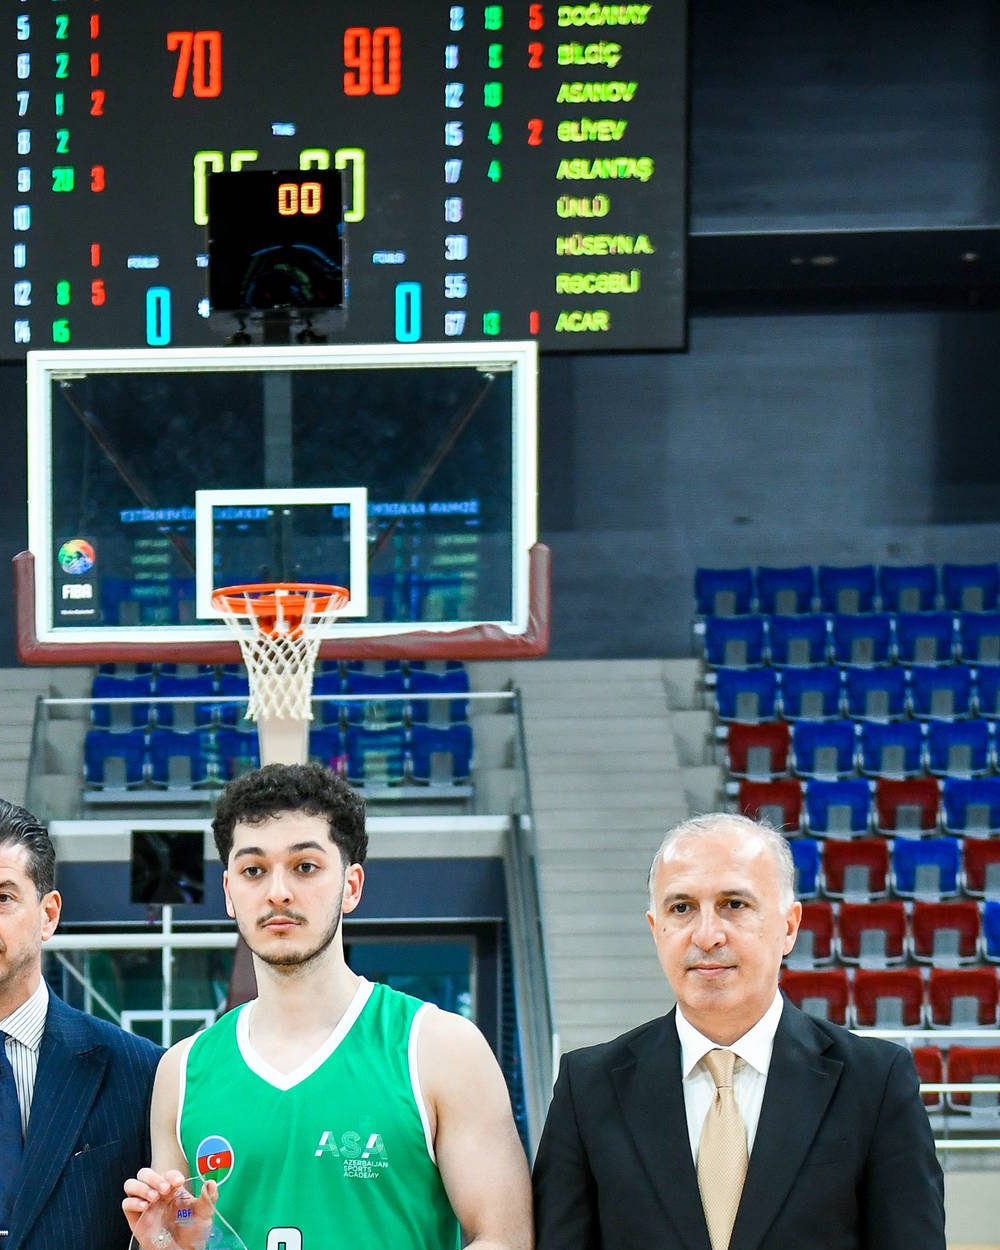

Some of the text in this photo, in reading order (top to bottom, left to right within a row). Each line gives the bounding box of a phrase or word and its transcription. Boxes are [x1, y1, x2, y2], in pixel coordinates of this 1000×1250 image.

[17, 15, 30, 40] 5
[56, 15, 68, 39] 2
[90, 14, 99, 38] 1
[529, 4, 544, 30] 5
[17, 53, 30, 79] 6
[56, 53, 68, 78] 2
[90, 53, 99, 76] 1
[167, 31, 222, 98] 70
[344, 27, 401, 96] 90
[528, 42, 544, 69] 2
[17, 91, 29, 116] 7
[55, 93, 64, 115] 1
[90, 90, 105, 116] 2
[445, 82, 464, 108] 12
[18, 129, 30, 154] 8
[56, 129, 69, 153] 2
[445, 121, 464, 146] 15
[488, 122, 502, 144] 4
[528, 119, 543, 146] 2
[18, 167, 31, 192] 9
[52, 167, 74, 192] 20
[91, 165, 105, 192] 3
[445, 157, 654, 183] 17 4 ASLANTAŞ
[278, 182, 322, 215] 00
[557, 193, 609, 218] ÜNLÜ
[91, 244, 100, 267] 1
[445, 235, 468, 260] 30
[14, 280, 31, 306] 12
[57, 280, 70, 305] 8
[92, 280, 105, 306] 5
[445, 273, 468, 298] 55
[146, 286, 171, 345] 0
[395, 282, 421, 342] 0
[530, 311, 539, 334] 1
[555, 310, 609, 332] ACAR
[314, 1130, 388, 1160] ASA
[343, 1160, 389, 1168] AZERBAIJAN
[177, 1208, 193, 1219] ABF
